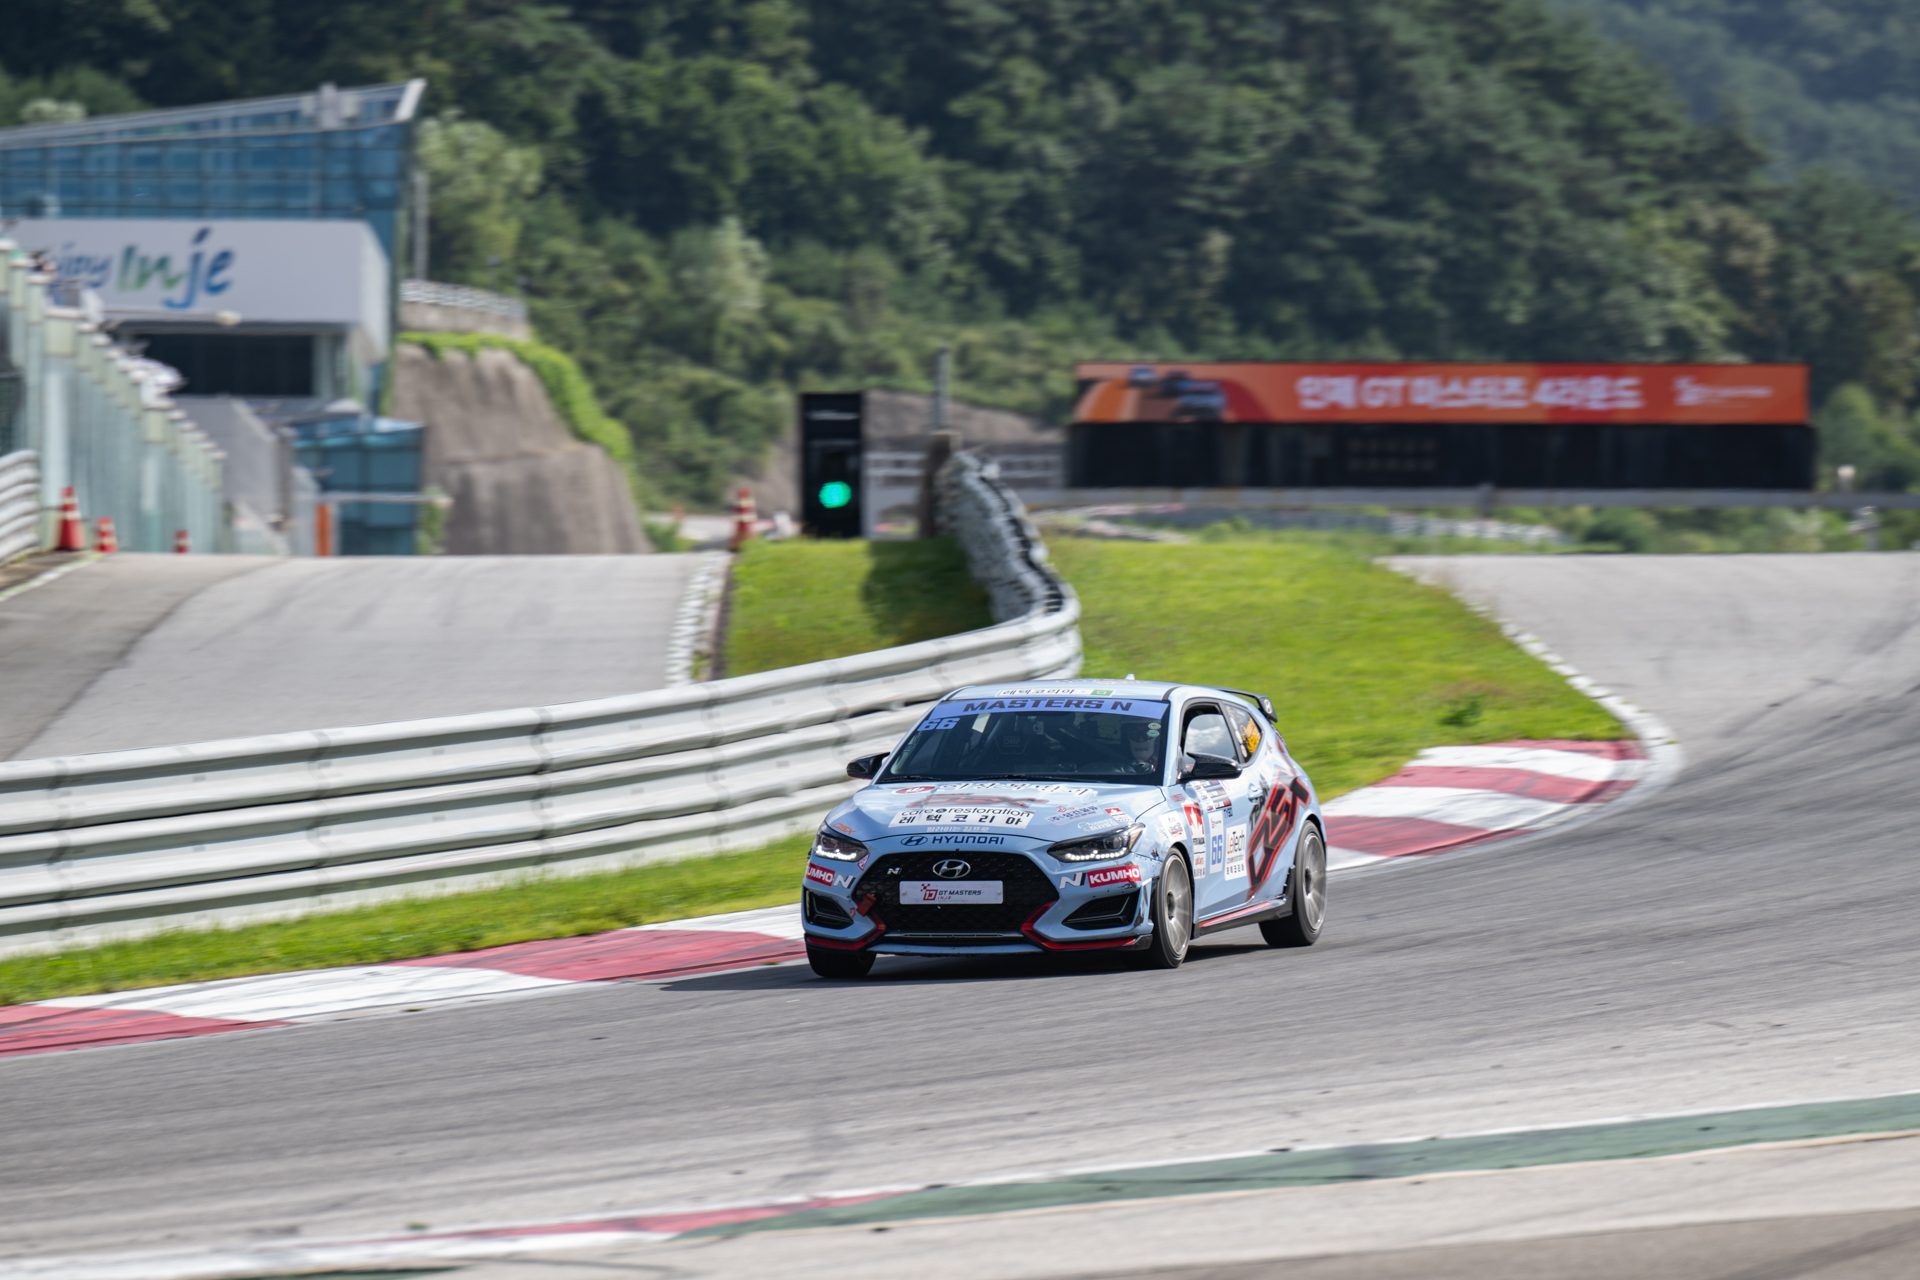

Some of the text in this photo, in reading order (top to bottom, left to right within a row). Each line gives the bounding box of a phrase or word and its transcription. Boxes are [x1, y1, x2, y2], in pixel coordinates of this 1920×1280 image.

[1361, 376, 1405, 408] GT
[963, 699, 1133, 712] MASTERS N
[917, 718, 960, 731] 66
[932, 835, 1004, 845] HYUNDAI
[1211, 835, 1223, 865] 66
[807, 866, 833, 883] UMHO
[1090, 868, 1140, 884] KUMHO
